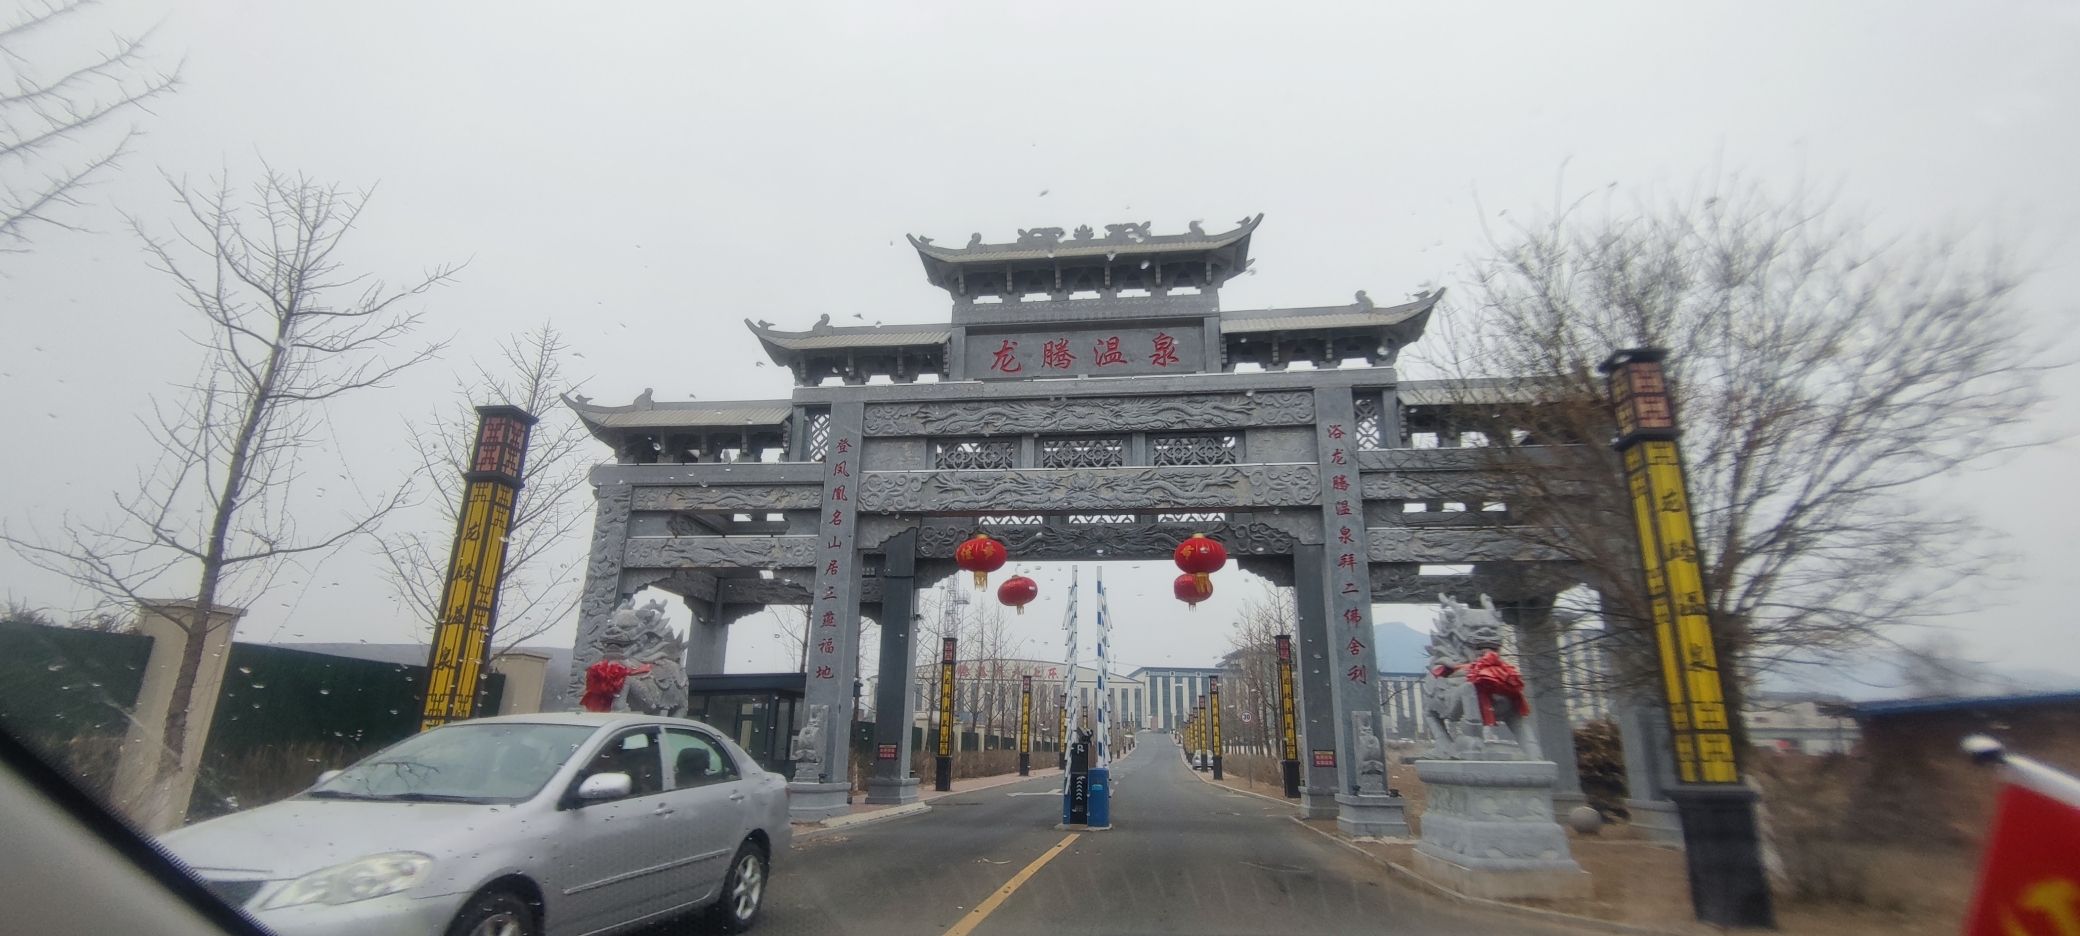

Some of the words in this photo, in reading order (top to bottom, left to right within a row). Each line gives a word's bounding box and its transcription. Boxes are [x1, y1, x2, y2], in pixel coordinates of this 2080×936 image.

[990, 332, 1179, 373] 龙腾温泉
[815, 438, 853, 680] 登凤凰名山居三燕福地
[1327, 424, 1369, 684] 浴龙腾温泉拜二佛舍利
